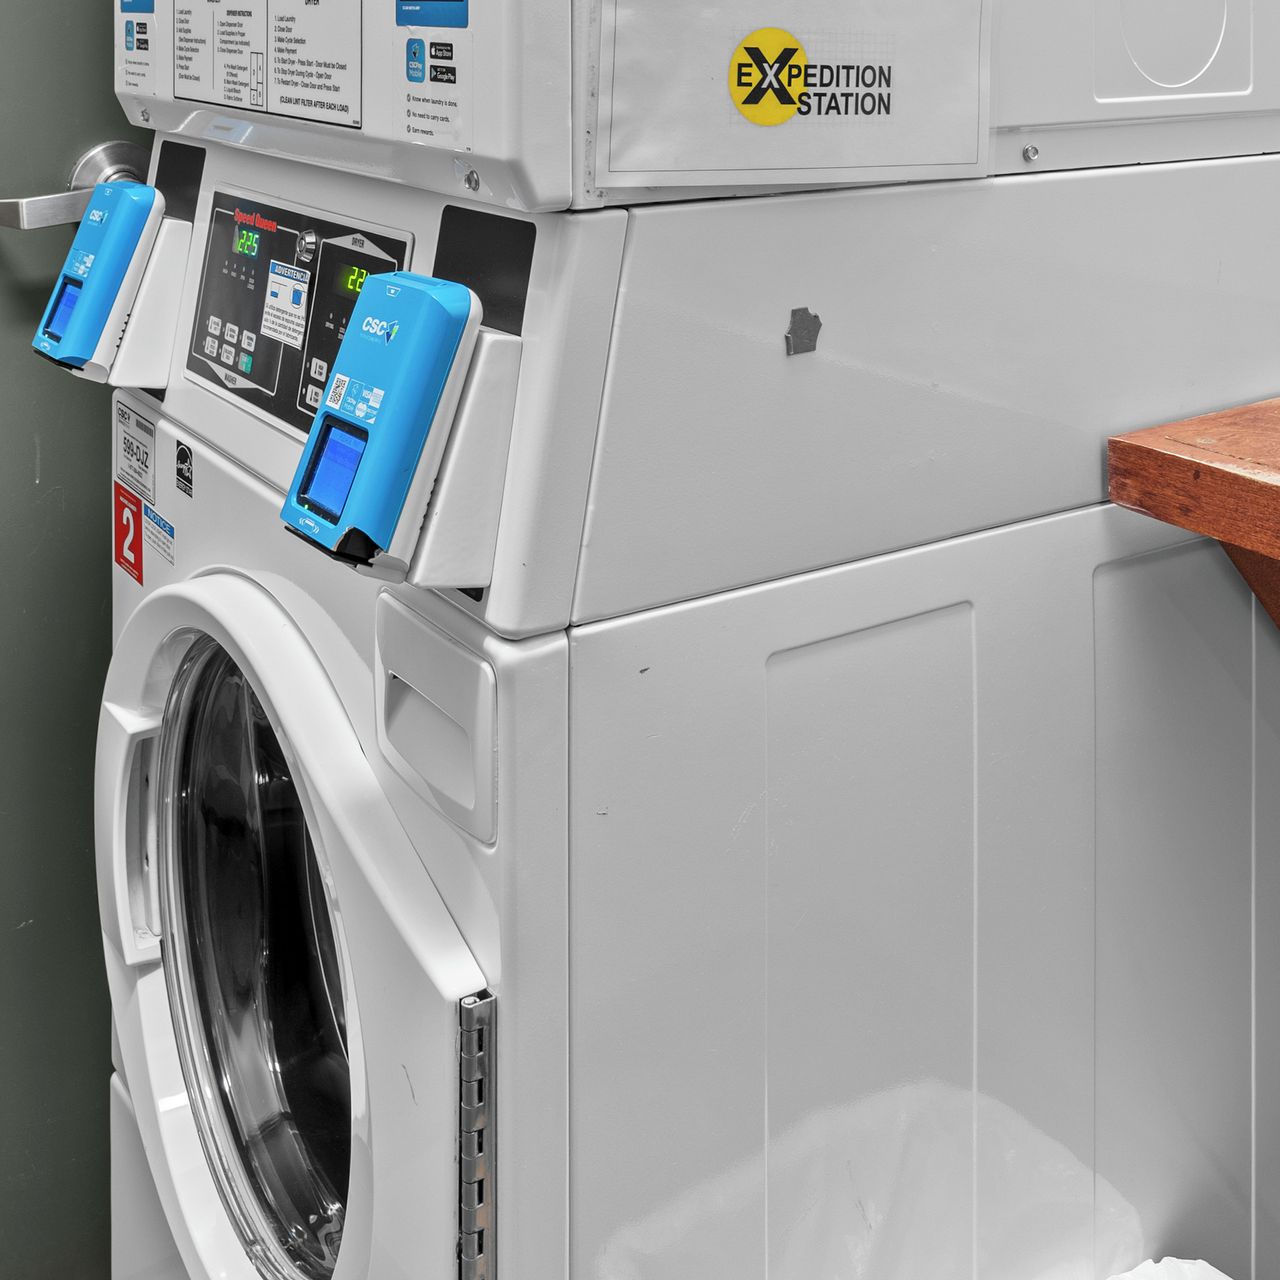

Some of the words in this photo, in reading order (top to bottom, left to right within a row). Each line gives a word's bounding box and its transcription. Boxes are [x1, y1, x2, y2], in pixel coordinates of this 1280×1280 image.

[797, 92, 891, 115] STATION
[352, 237, 364, 248] DRYER
[348, 267, 370, 292] 22
[362, 316, 386, 335] CSC
[123, 437, 149, 469] 599-DJZ
[148, 508, 170, 534] NOTICE
[122, 507, 134, 564] 2
